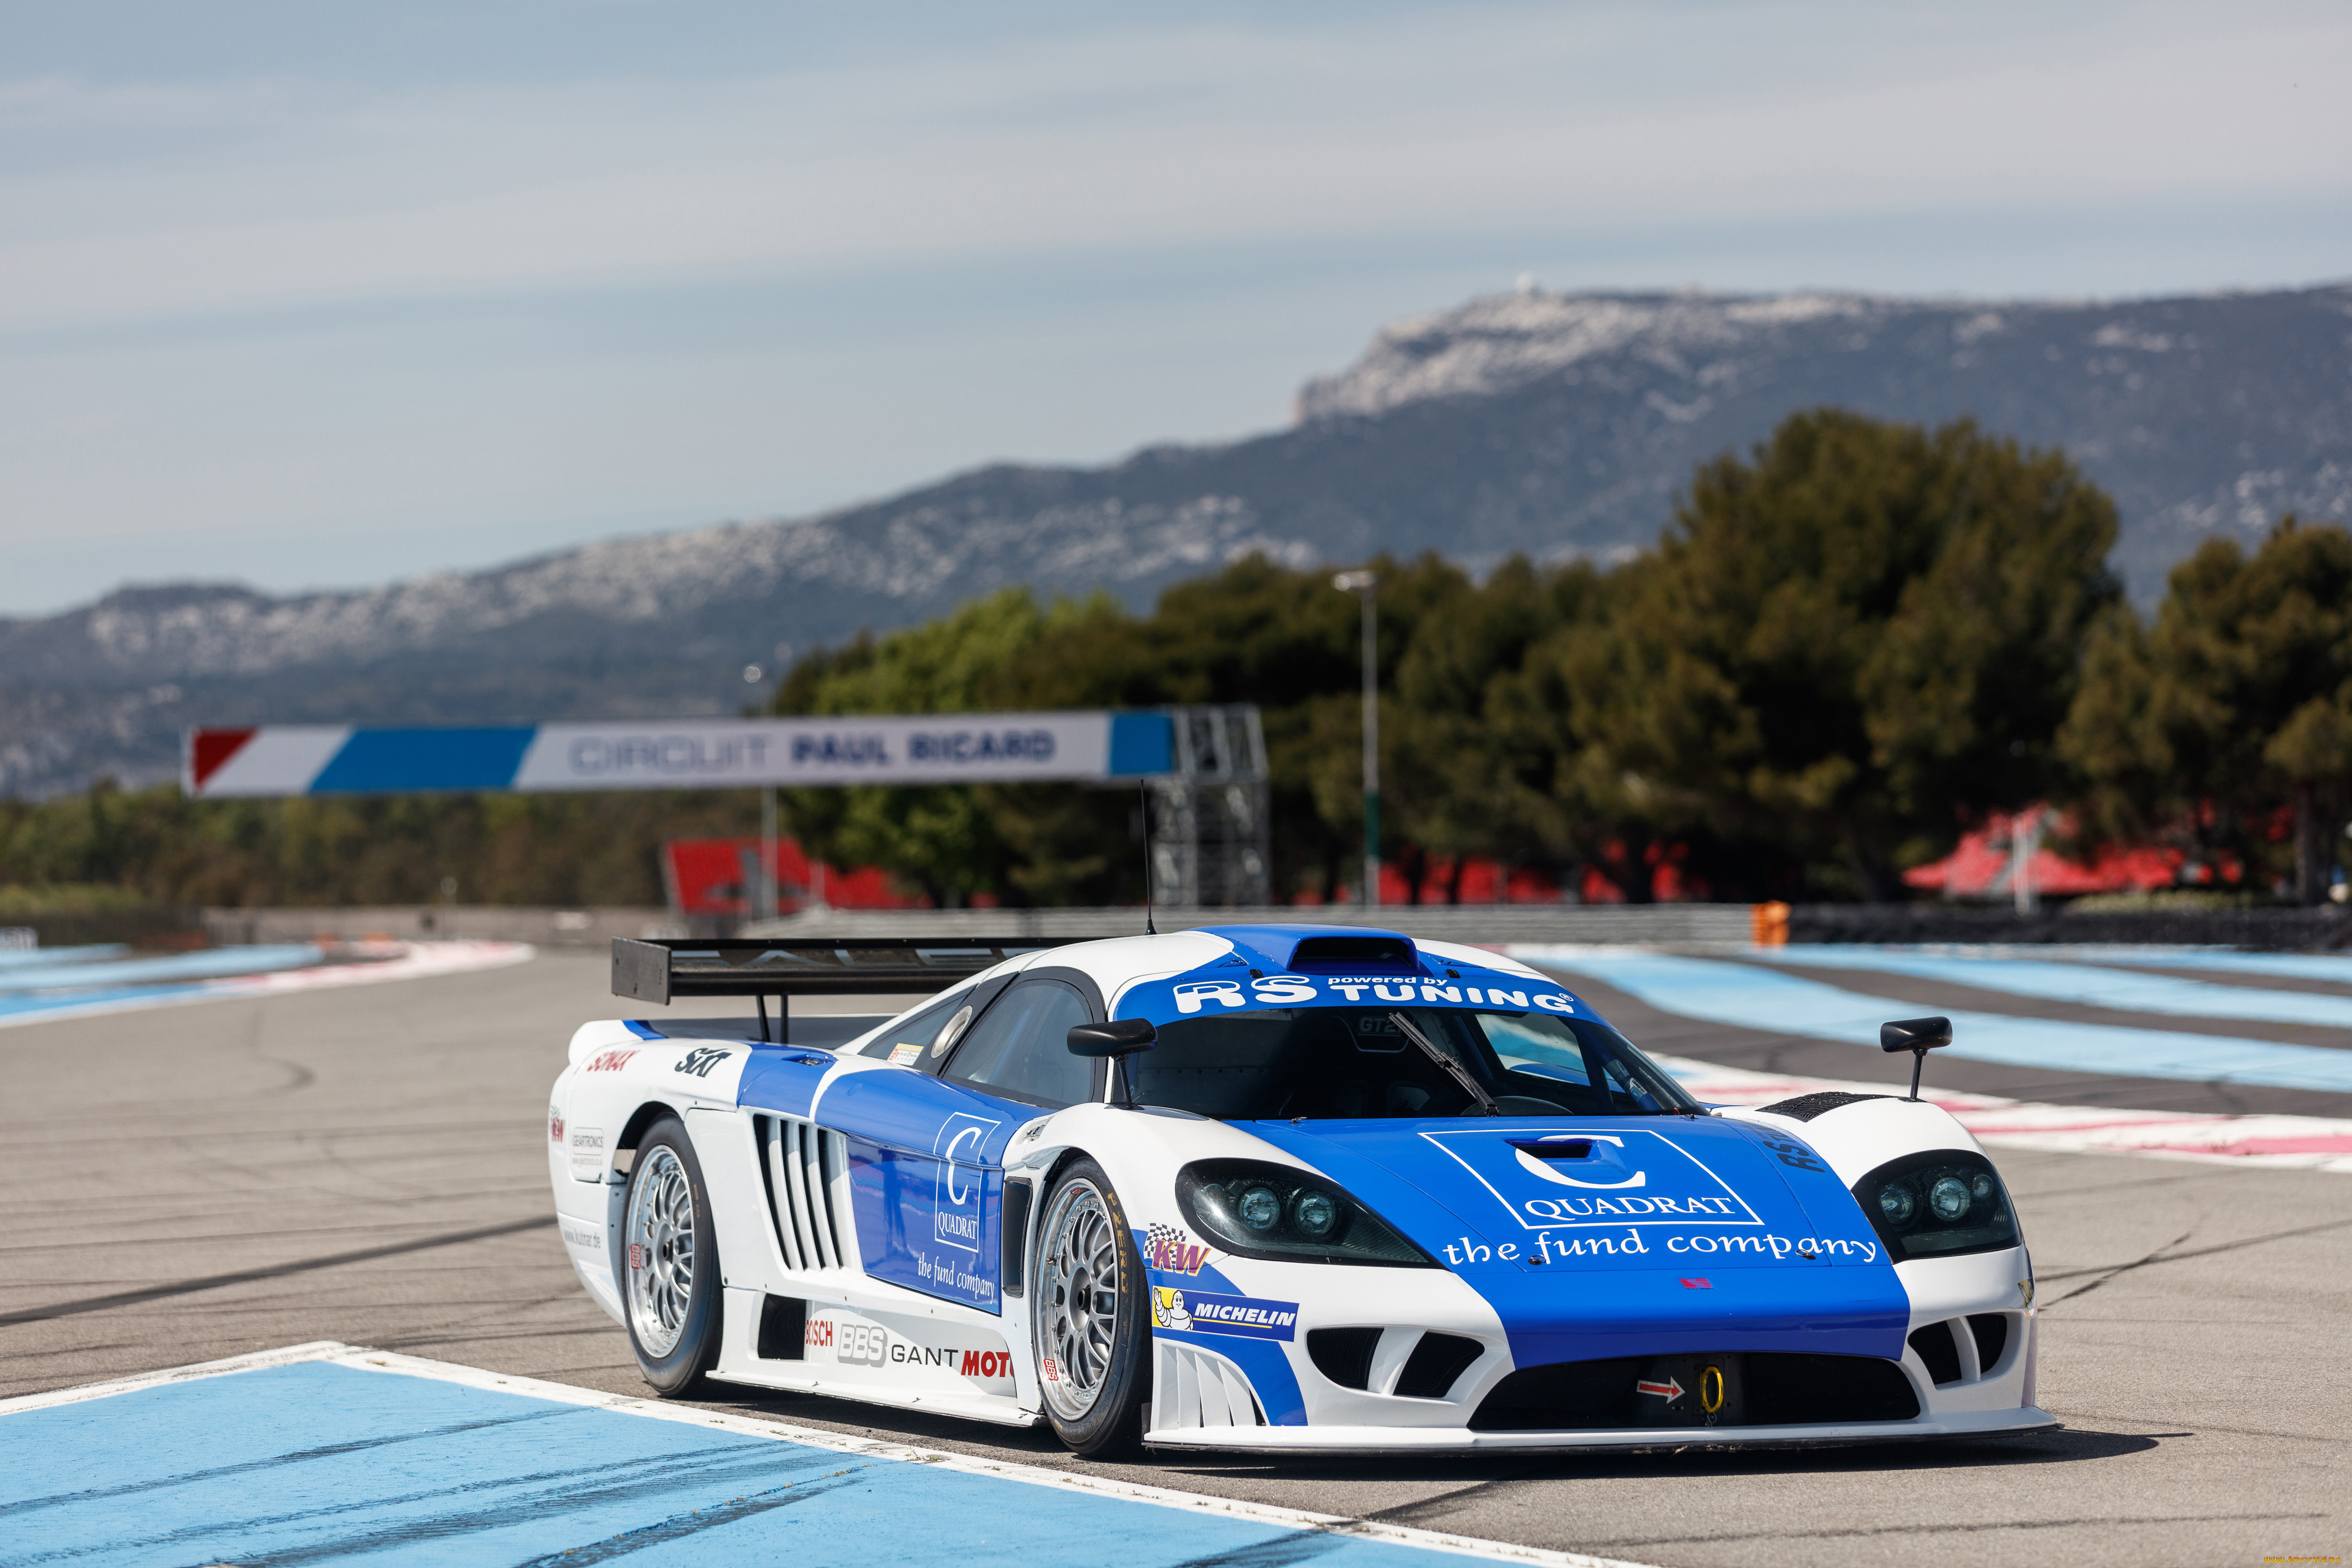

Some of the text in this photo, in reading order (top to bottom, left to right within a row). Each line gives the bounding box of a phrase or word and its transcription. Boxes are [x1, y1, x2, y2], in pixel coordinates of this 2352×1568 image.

[568, 729, 1057, 775] CIRCUIT PAUL RICARD
[1172, 975, 1317, 1014] RS
[1328, 976, 1448, 985] powered by
[946, 1126, 982, 1205] C
[1515, 1134, 1646, 1189] C
[938, 1211, 977, 1240] QUADRAT
[1525, 1196, 1736, 1221] QUADRAT
[1152, 1238, 1211, 1276] KW
[1443, 1228, 1877, 1265] the fund company
[918, 1252, 995, 1305] the fund company
[806, 1319, 833, 1347] BOSCH
[1195, 1303, 1296, 1326] MICHELIN
[837, 1323, 888, 1368] BBS
[891, 1344, 959, 1368] GANT
[1044, 1359, 1058, 1381] BBS
